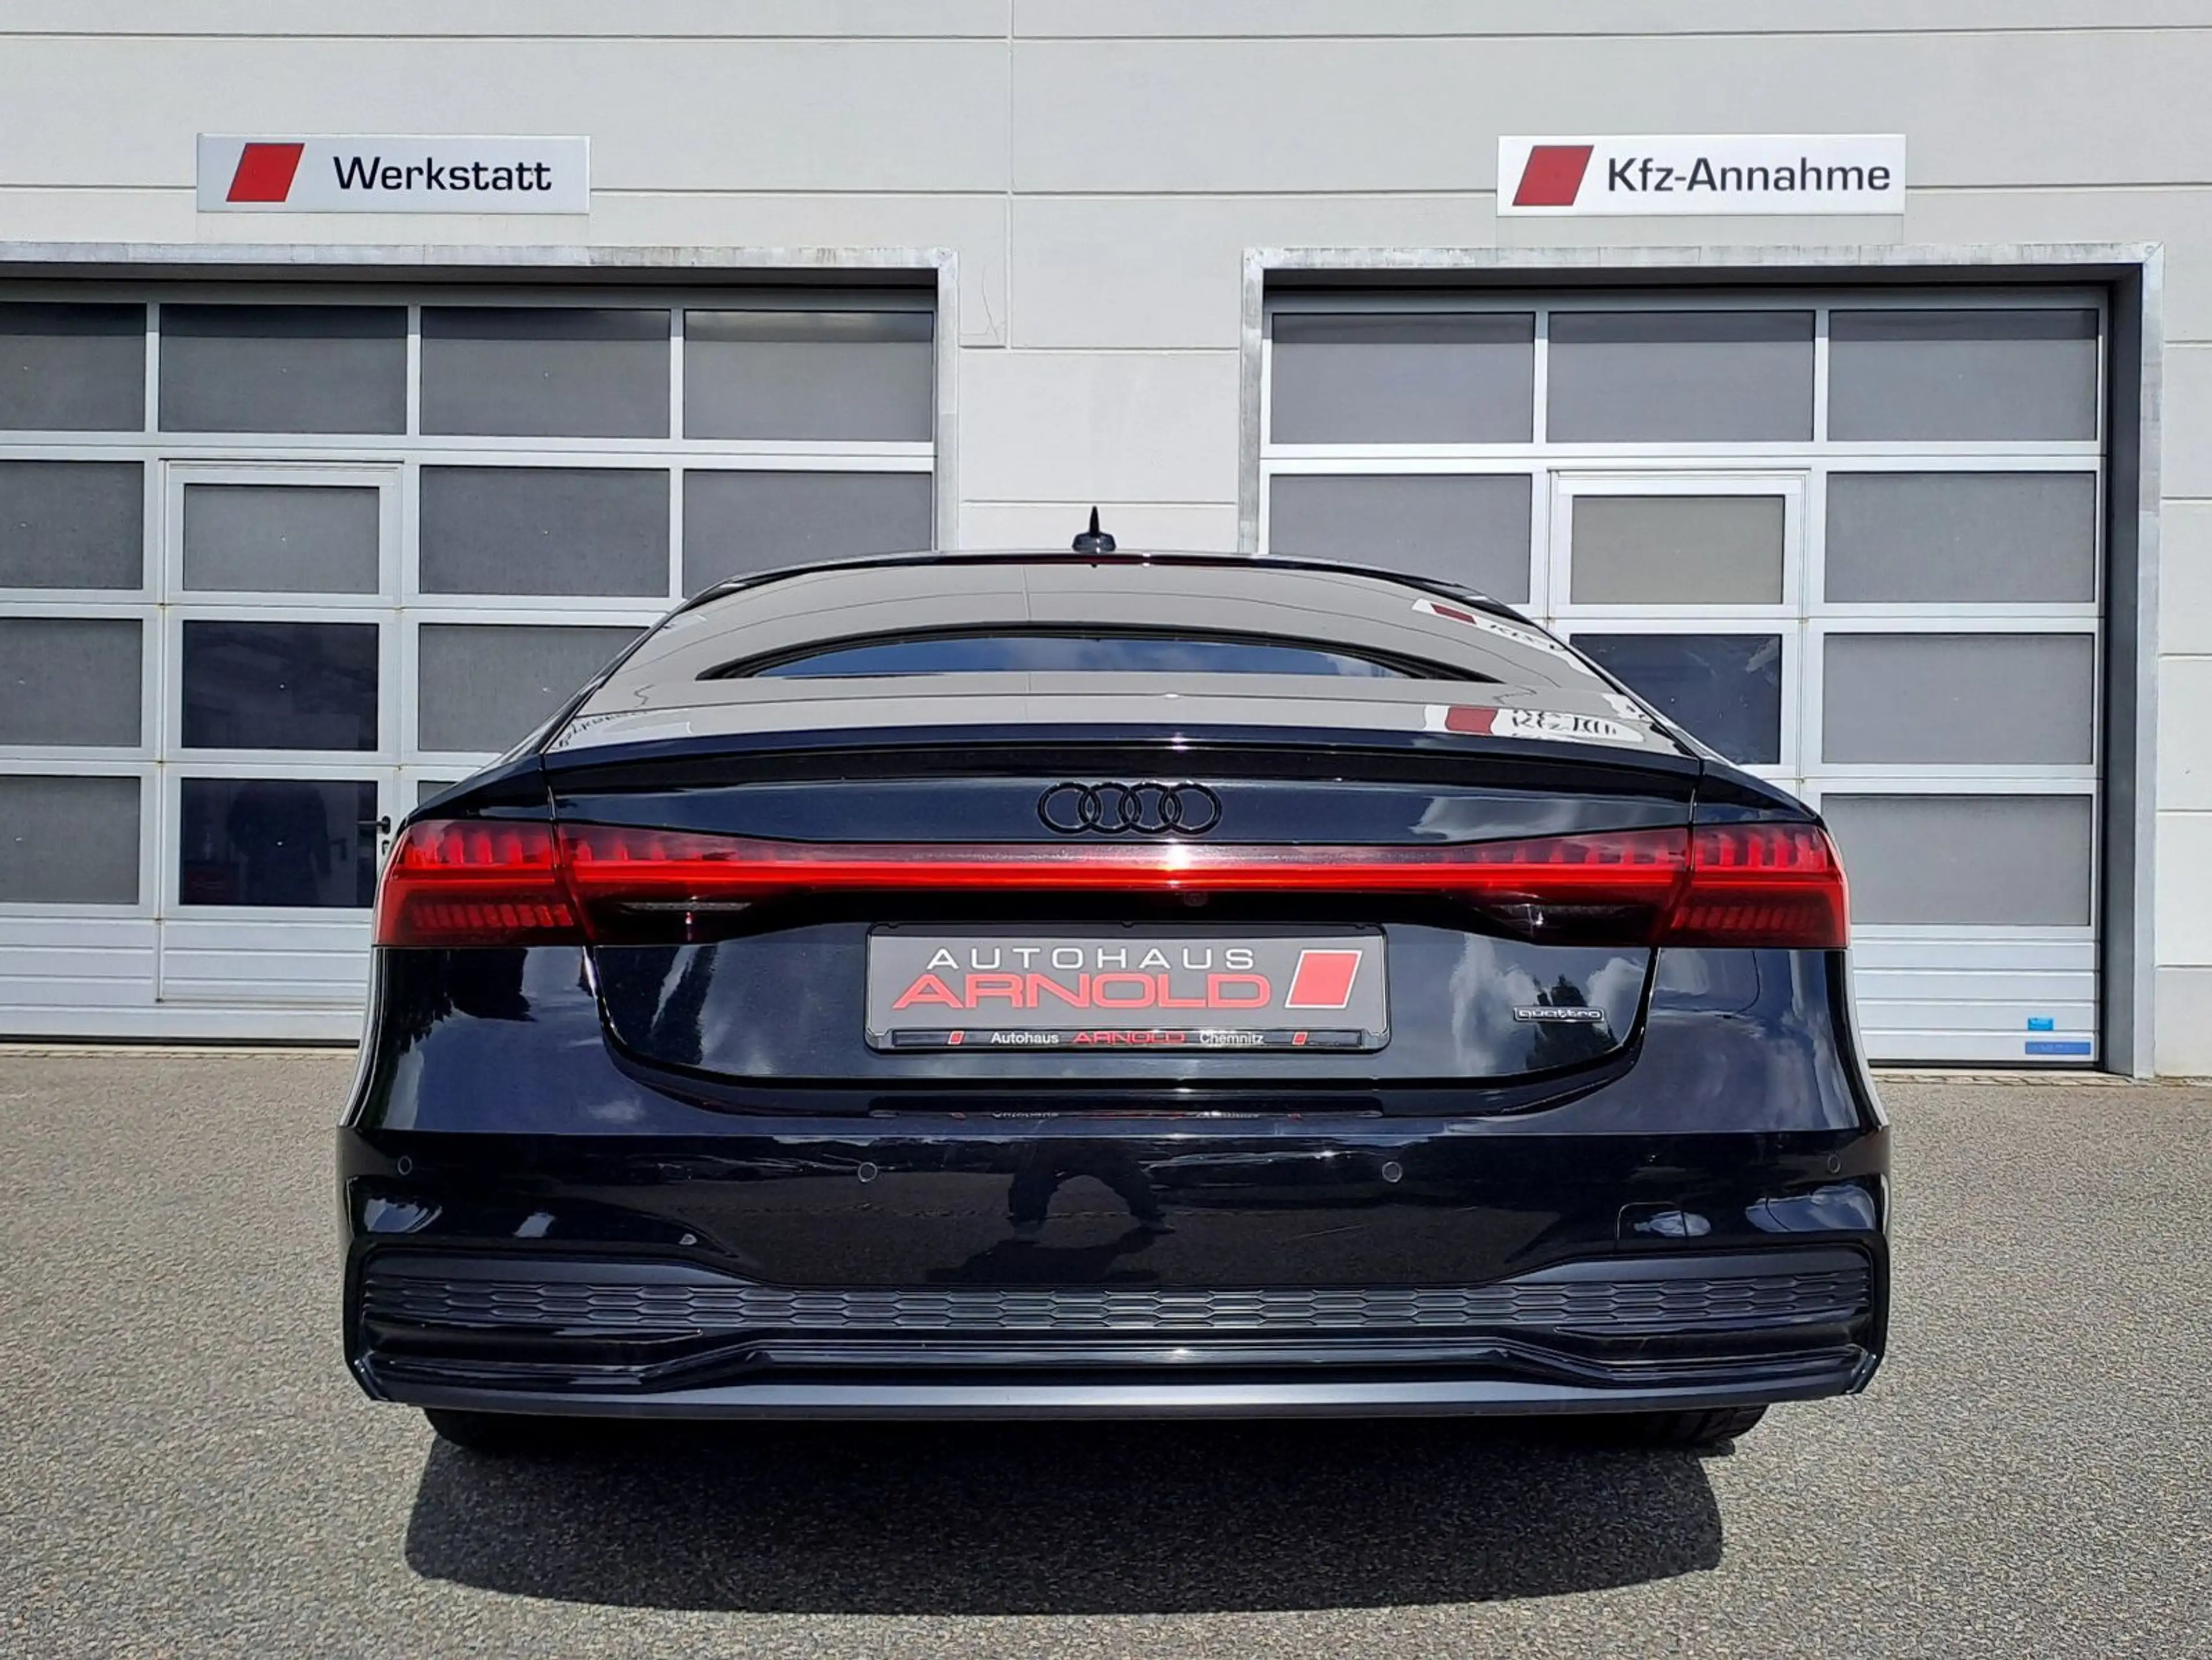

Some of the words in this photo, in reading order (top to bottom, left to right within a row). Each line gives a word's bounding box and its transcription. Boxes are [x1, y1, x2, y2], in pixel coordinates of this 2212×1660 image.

[333, 156, 552, 191] Werkstatt
[1608, 157, 1890, 191] Kfz-Annahme
[926, 947, 1254, 971] AUTOHAUS
[892, 973, 1271, 1009] ARNOLD
[1518, 1009, 1601, 1020] quattro
[991, 1032, 1059, 1044] Autohaus
[1073, 1031, 1186, 1044] ARNOLD
[1199, 1031, 1264, 1045] Chemnitz
